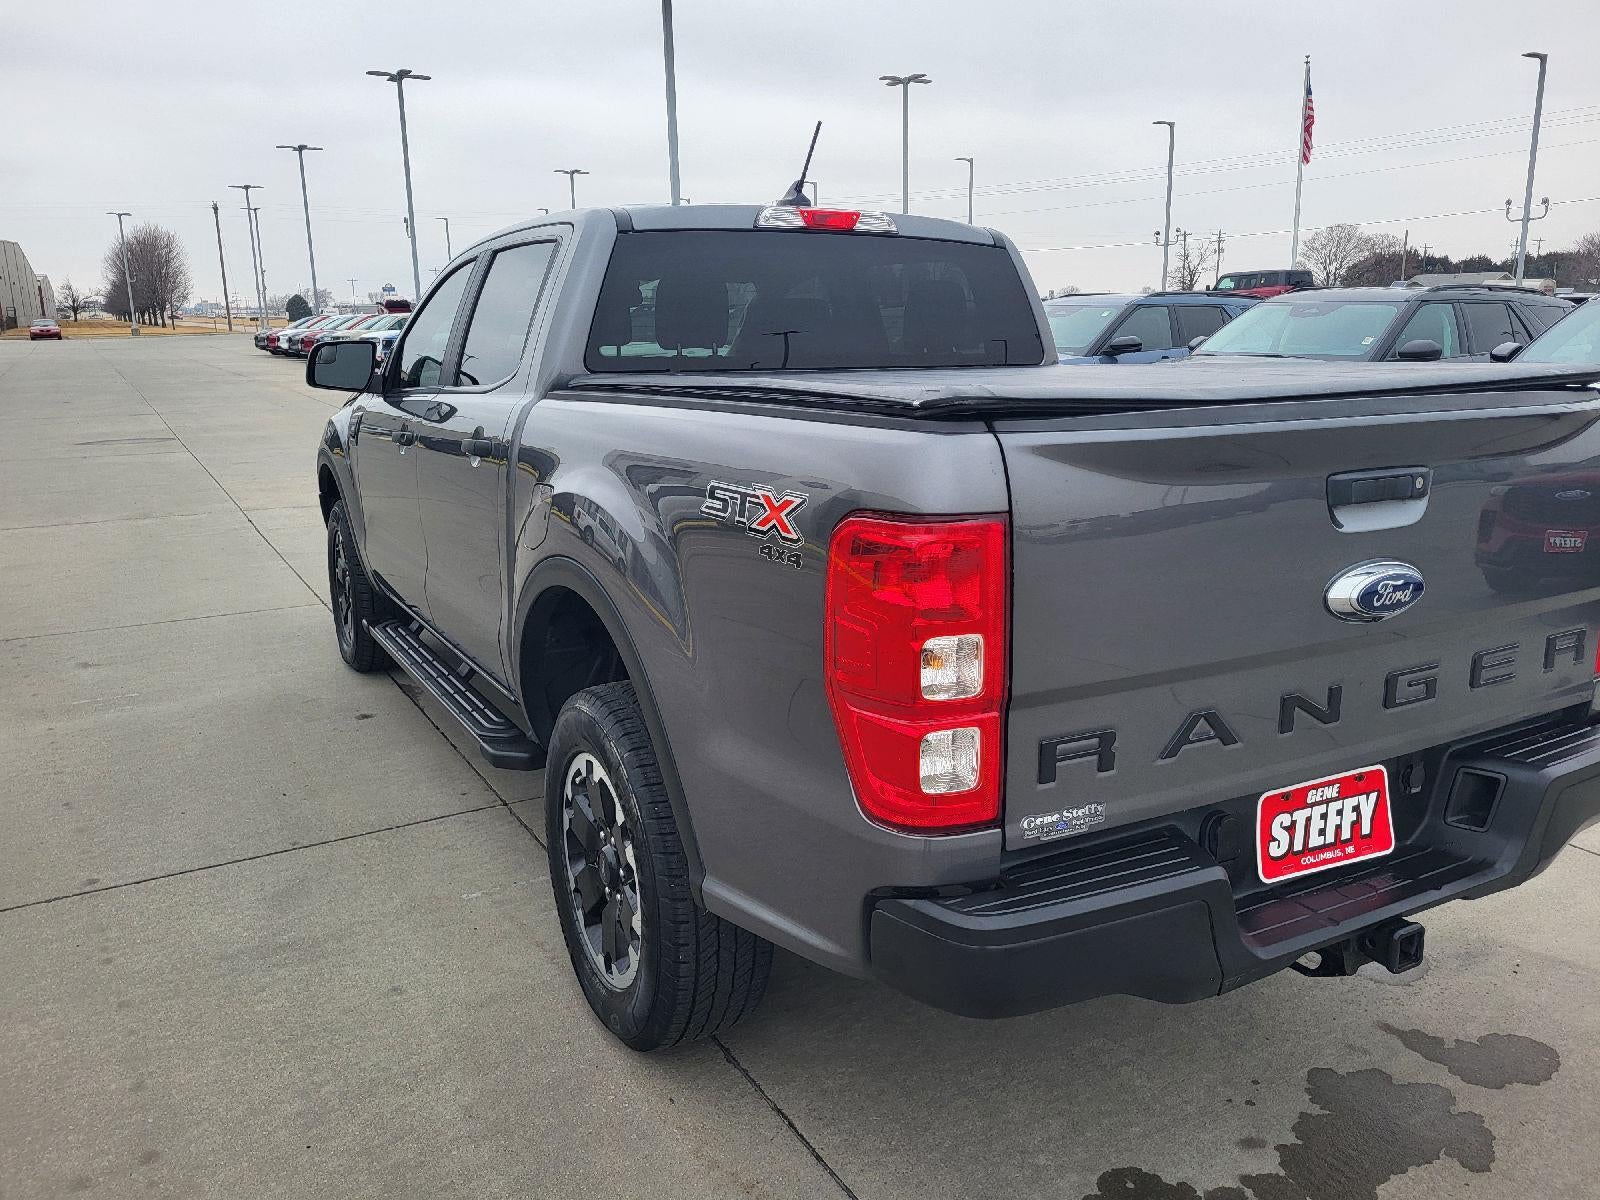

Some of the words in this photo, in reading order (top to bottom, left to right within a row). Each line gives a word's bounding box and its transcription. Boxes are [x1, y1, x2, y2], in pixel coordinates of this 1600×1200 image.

[699, 480, 809, 548] STX
[1373, 579, 1413, 607] Ford
[1037, 627, 1587, 785] RANGER
[1306, 783, 1340, 804] GENE
[1022, 813, 1061, 830] Gene
[1062, 803, 1105, 821] Steffy
[1268, 790, 1379, 859] STEFFY
[1300, 848, 1344, 865] COLUMBUS,
[1345, 845, 1355, 855] NE
